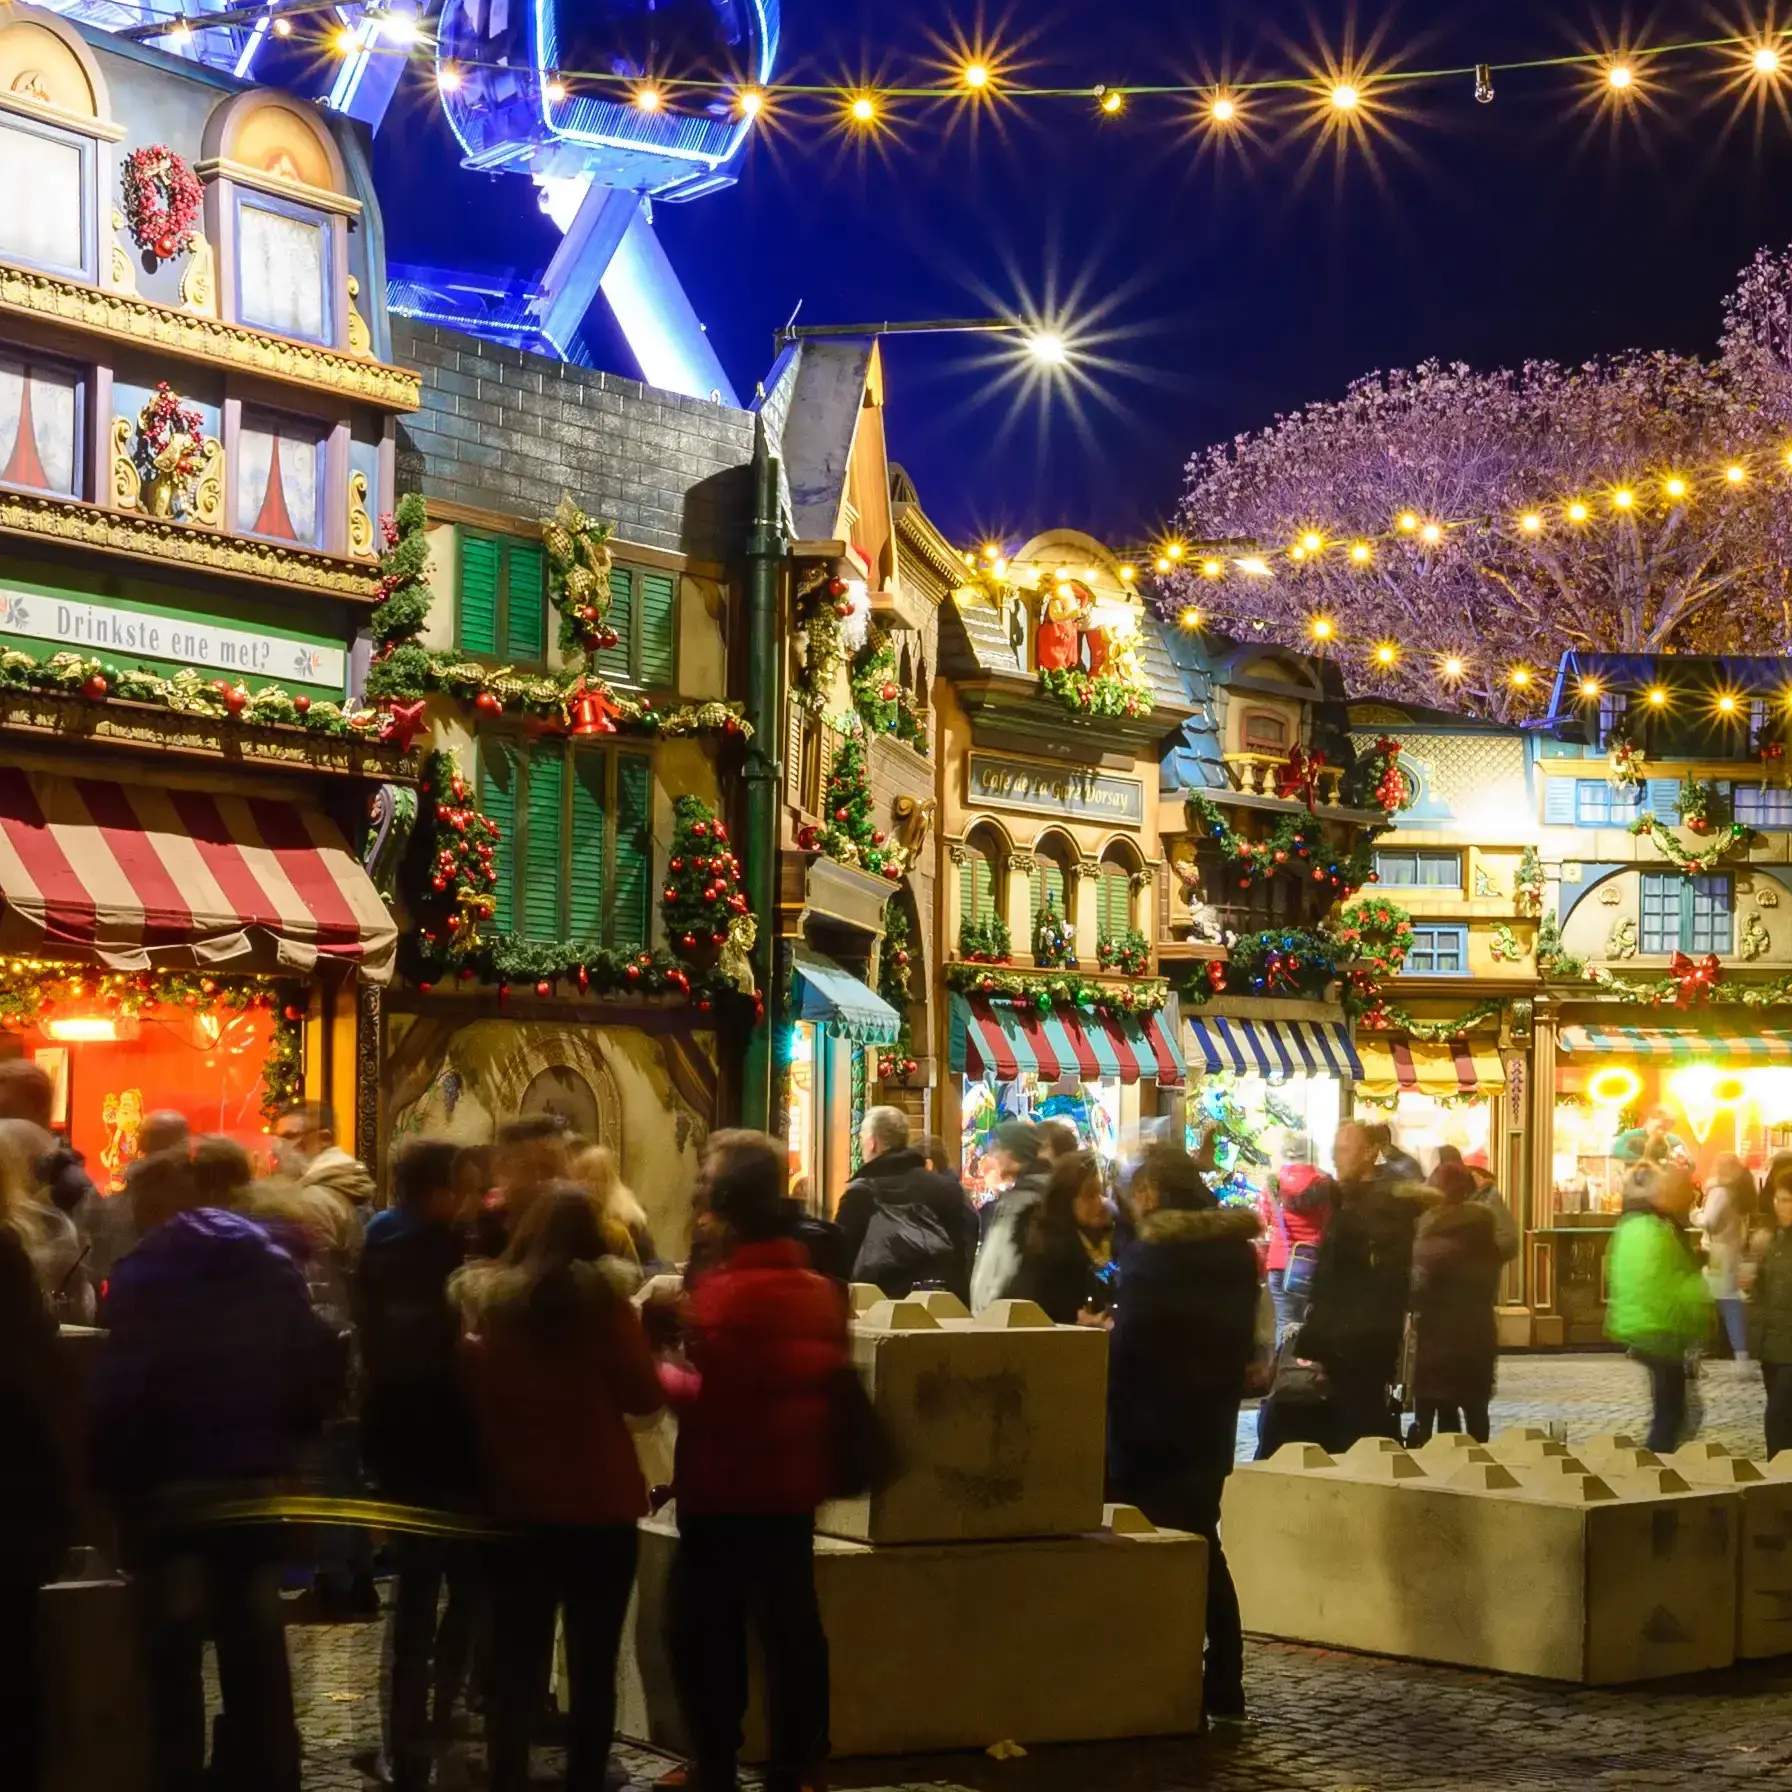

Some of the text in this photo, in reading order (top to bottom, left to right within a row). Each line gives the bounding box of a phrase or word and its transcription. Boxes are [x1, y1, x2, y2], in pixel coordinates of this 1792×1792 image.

[57, 606, 270, 669] Drinkste ene met?
[1013, 771, 1029, 793] de
